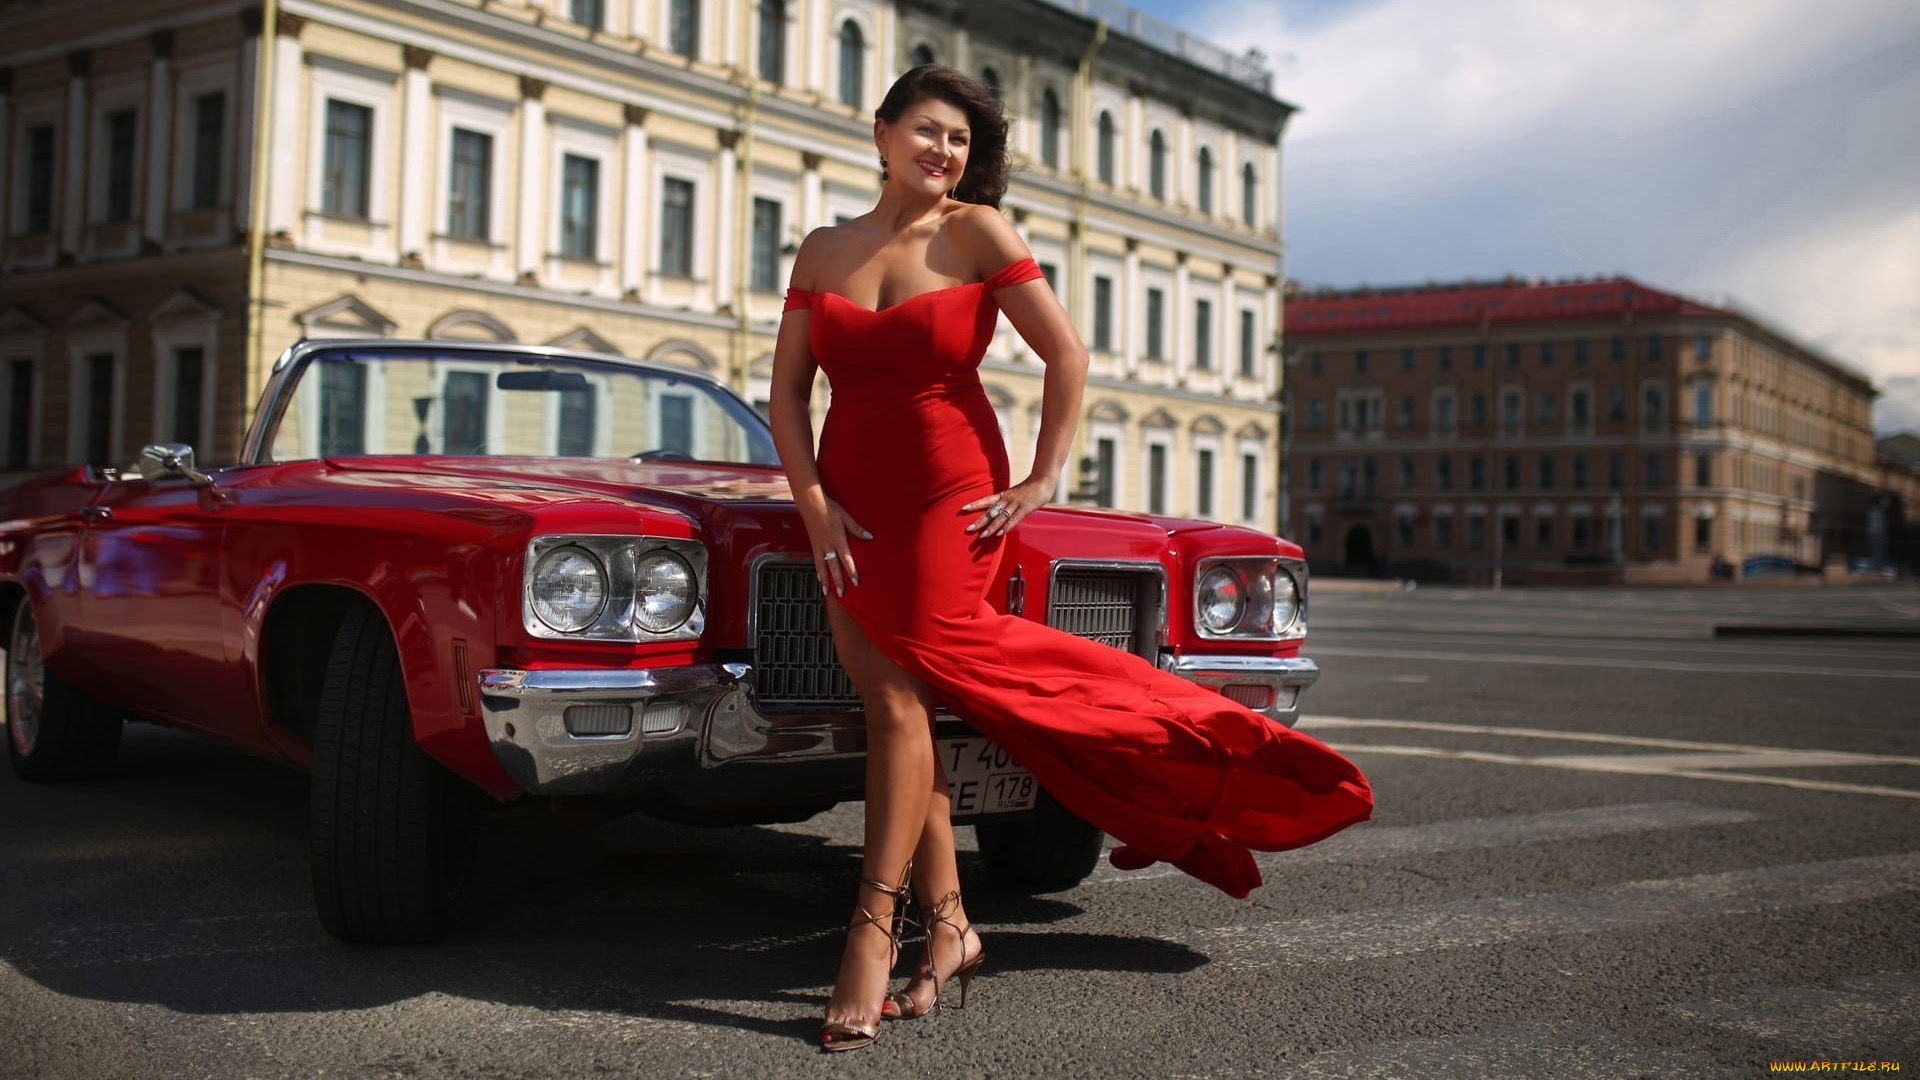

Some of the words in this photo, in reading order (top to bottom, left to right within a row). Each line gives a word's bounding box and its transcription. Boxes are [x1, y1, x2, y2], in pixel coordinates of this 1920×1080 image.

[950, 742, 968, 772] T
[995, 776, 1033, 800] 178
[998, 800, 1016, 808] RUS
